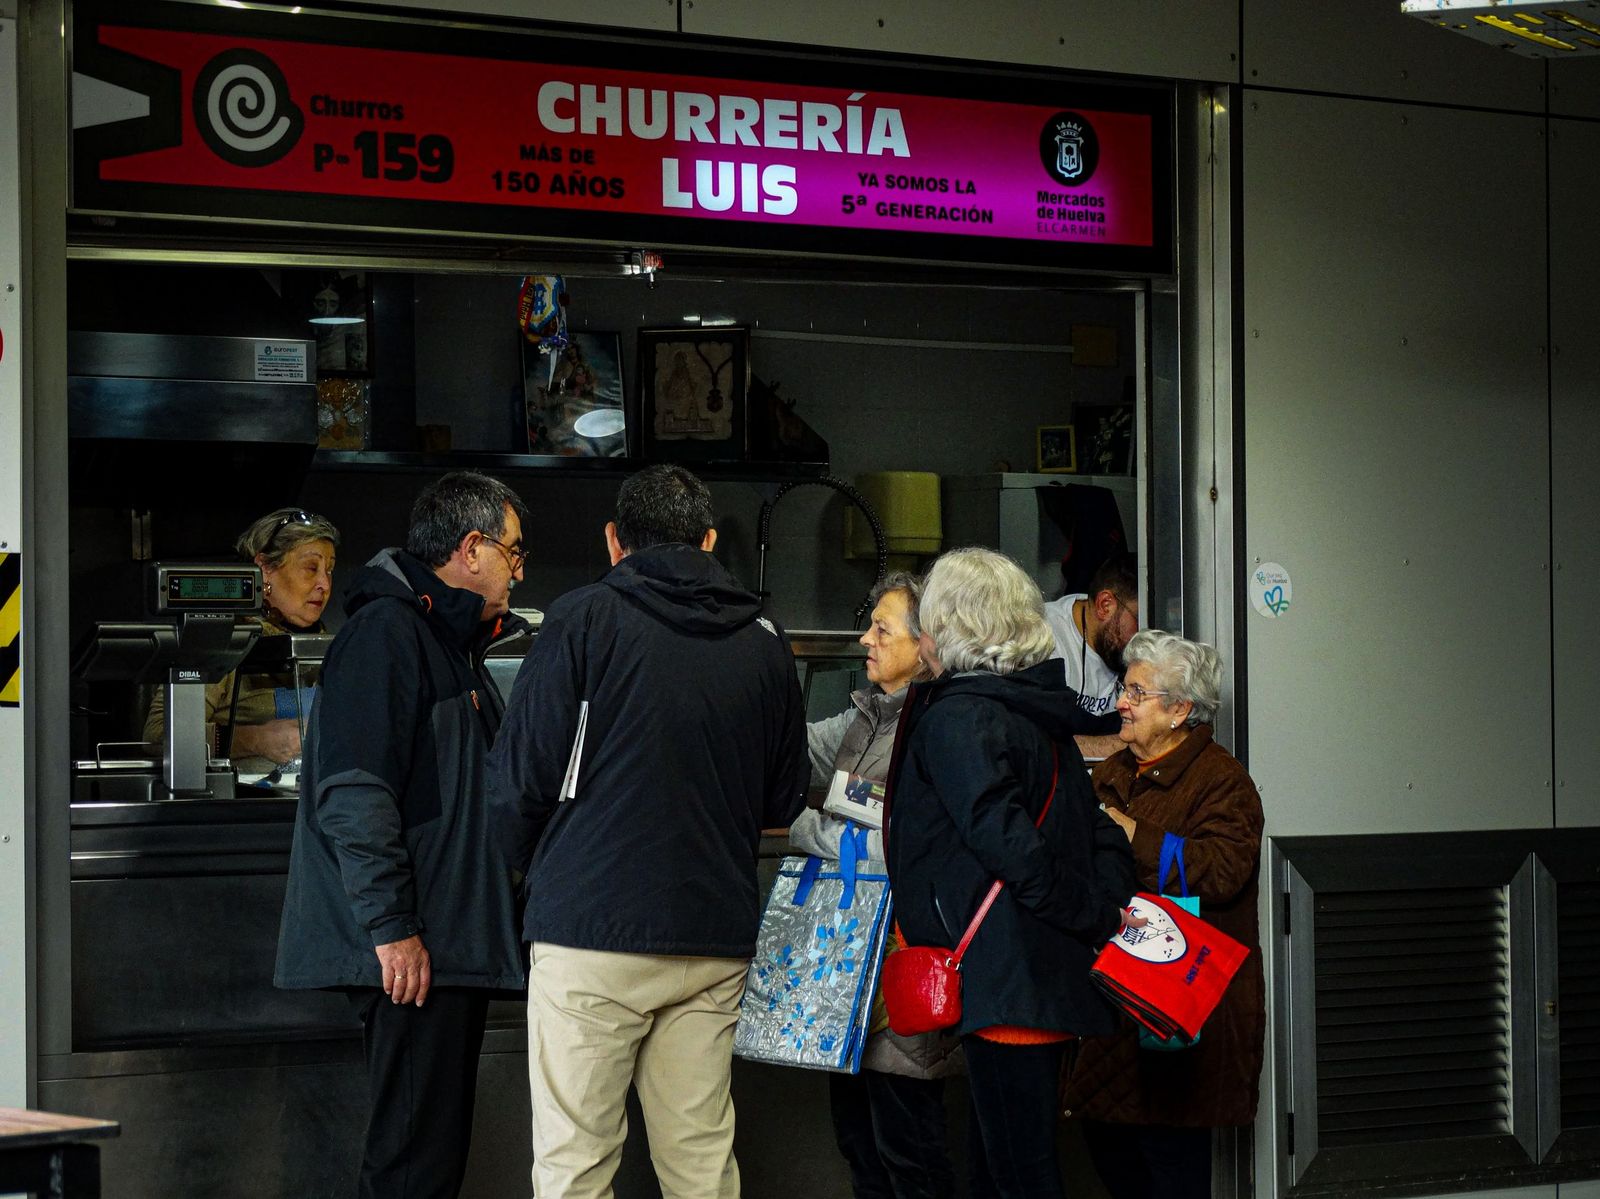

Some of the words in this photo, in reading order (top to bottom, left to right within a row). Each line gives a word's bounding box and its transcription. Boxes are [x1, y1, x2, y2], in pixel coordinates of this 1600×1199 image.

[310, 94, 404, 121] Churros
[536, 80, 911, 158] CHURRERÍA
[520, 142, 562, 162] MÁS
[569, 147, 595, 165] DE
[492, 170, 540, 193] 150
[550, 169, 625, 199] AÑOS
[662, 156, 799, 216] LUIS
[858, 171, 879, 188] YA
[885, 174, 949, 193] SOMOS
[955, 179, 977, 195] LA
[1037, 191, 1105, 208] Mercados
[876, 201, 994, 224] GENERACIÓN
[1037, 206, 1055, 220] de
[1057, 207, 1105, 224] Huelva
